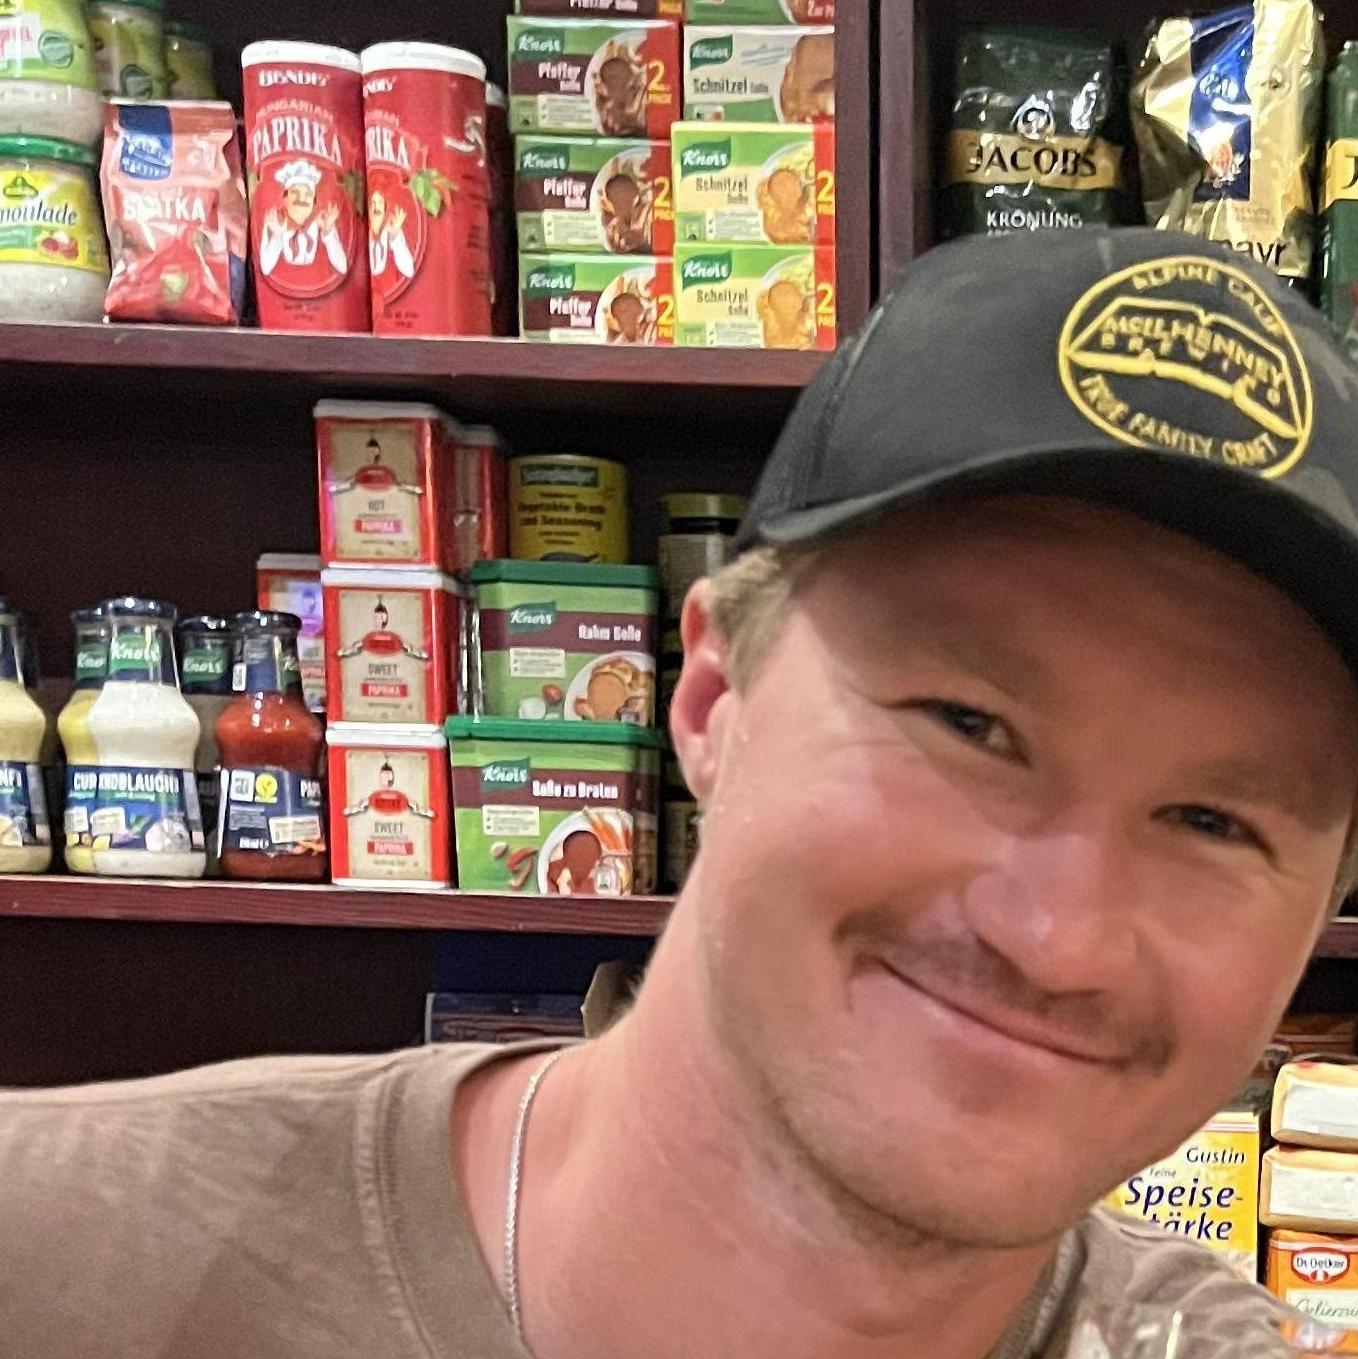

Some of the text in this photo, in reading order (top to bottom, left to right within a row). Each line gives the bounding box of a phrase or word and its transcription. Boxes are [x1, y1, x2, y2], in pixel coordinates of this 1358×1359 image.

[648, 60, 668, 92] 2
[692, 76, 748, 95] Schnitzel
[252, 114, 343, 168] PAPRIKA
[683, 149, 729, 167] Knorr
[966, 145, 1098, 177] JACOBS
[653, 176, 672, 208] 2
[695, 175, 748, 193] Schnitzel
[816, 170, 834, 202] 2
[684, 260, 729, 278] Knorr
[656, 294, 675, 325] 2
[696, 288, 749, 305] Schnitzel
[816, 282, 834, 314] 2
[509, 609, 554, 625] Knorr
[1185, 1147, 1246, 1165] Gustin
[1124, 1176, 1244, 1216] Speise-
